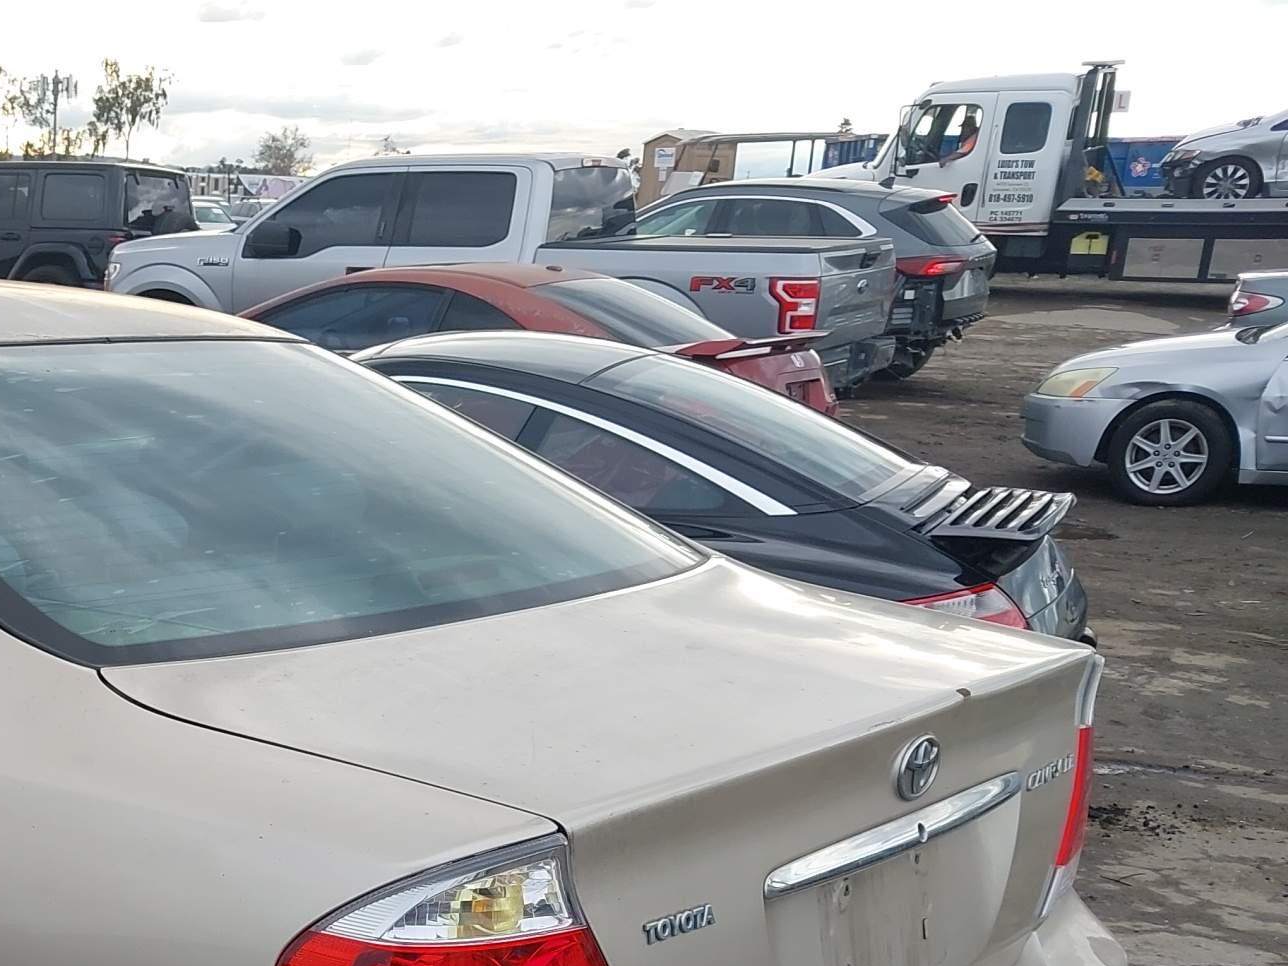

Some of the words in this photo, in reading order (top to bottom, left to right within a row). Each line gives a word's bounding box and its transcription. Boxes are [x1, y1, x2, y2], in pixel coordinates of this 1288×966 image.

[999, 171, 1037, 180] TRANSPORT
[689, 276, 756, 292] FX4
[642, 903, 716, 945] TOYOTA
